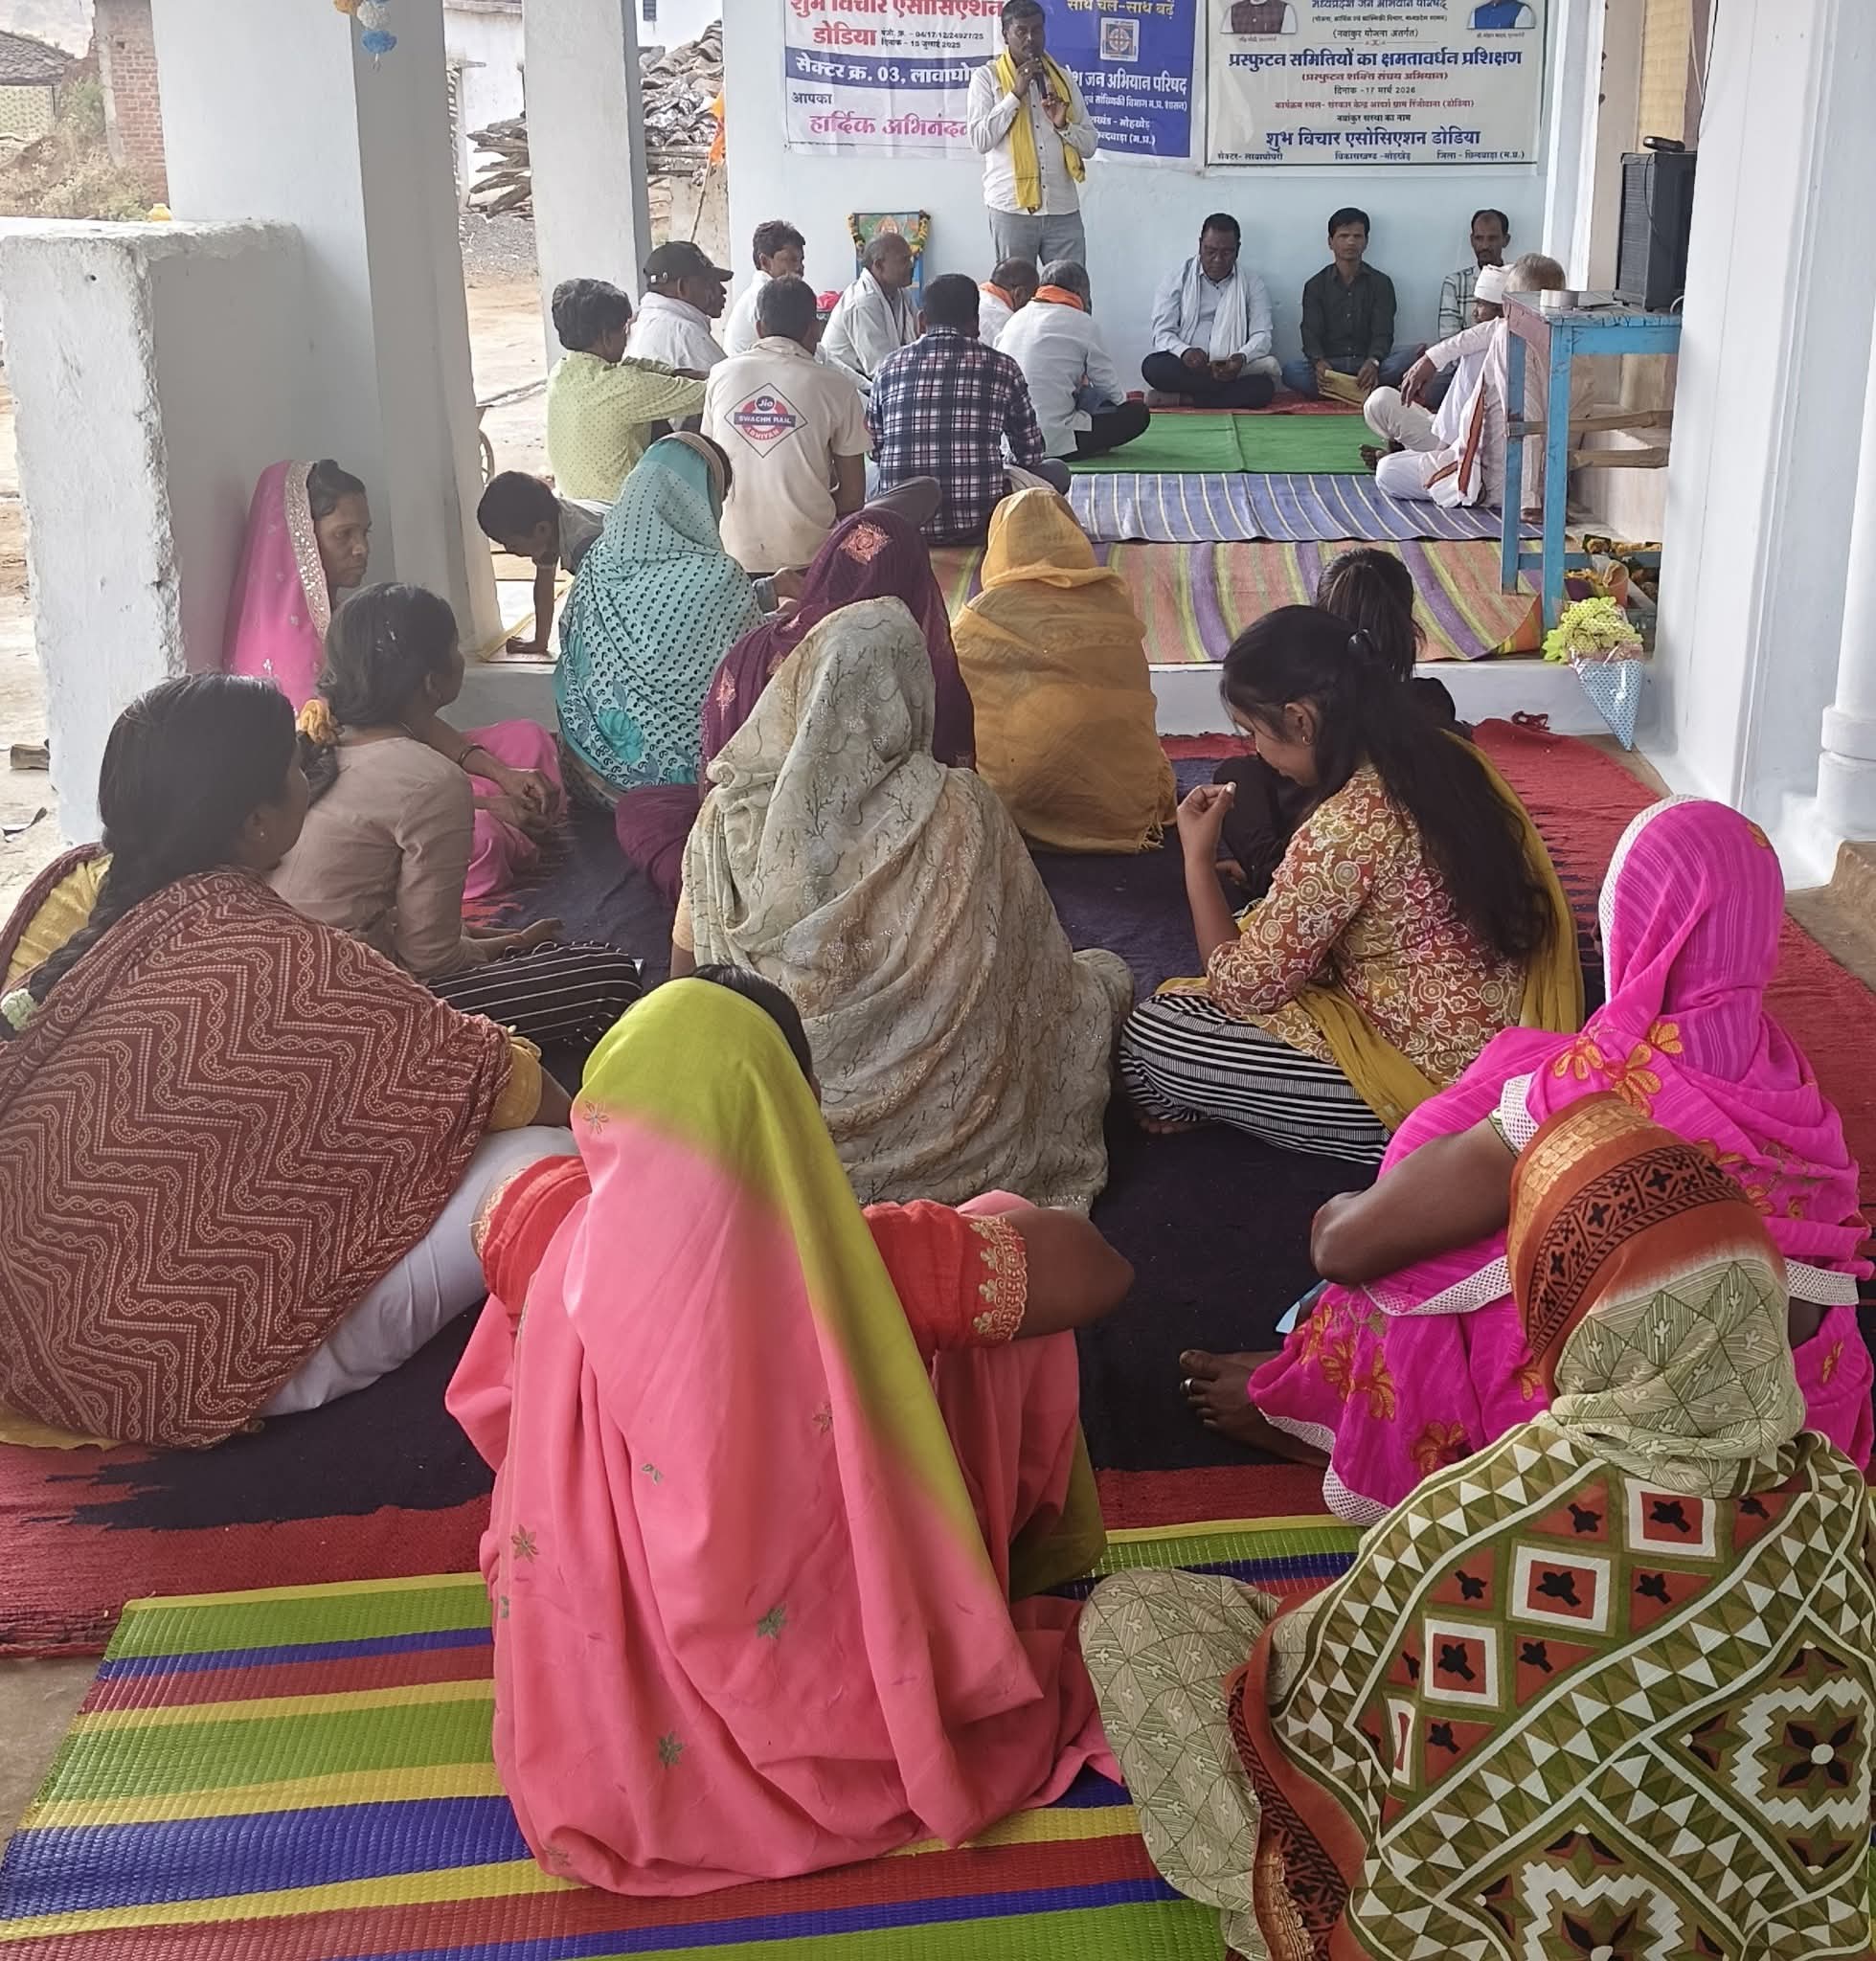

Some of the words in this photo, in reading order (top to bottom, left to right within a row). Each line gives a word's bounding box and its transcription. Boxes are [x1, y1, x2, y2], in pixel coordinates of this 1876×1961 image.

[791, 0, 826, 18] शुभ
[832, 0, 888, 14] विचार
[812, 20, 877, 46] डोडिया
[795, 52, 845, 78] सेक्टर
[847, 65, 873, 81] क्र.
[877, 66, 906, 84] 03,
[910, 61, 973, 83] लावाघो
[1229, 54, 1286, 72] प्रस्फुटन
[1289, 47, 1354, 66] समितियों
[1357, 53, 1377, 66] का
[1381, 47, 1458, 67] क्षमतावर्धन
[1461, 46, 1523, 66] प्रशिक्षण
[1084, 72, 1105, 88] जन
[1107, 67, 1151, 91] अभियान
[1153, 70, 1187, 95] परिषद
[792, 91, 833, 104] आपका
[809, 109, 876, 134] हार्दिक
[1266, 131, 1294, 152] शुभ
[1298, 126, 1341, 146] विचार
[1345, 125, 1427, 147] एसोसिएशन
[1431, 125, 1481, 145] डोडिया
[757, 398, 774, 407] Jio
[738, 415, 772, 423] SWACHH
